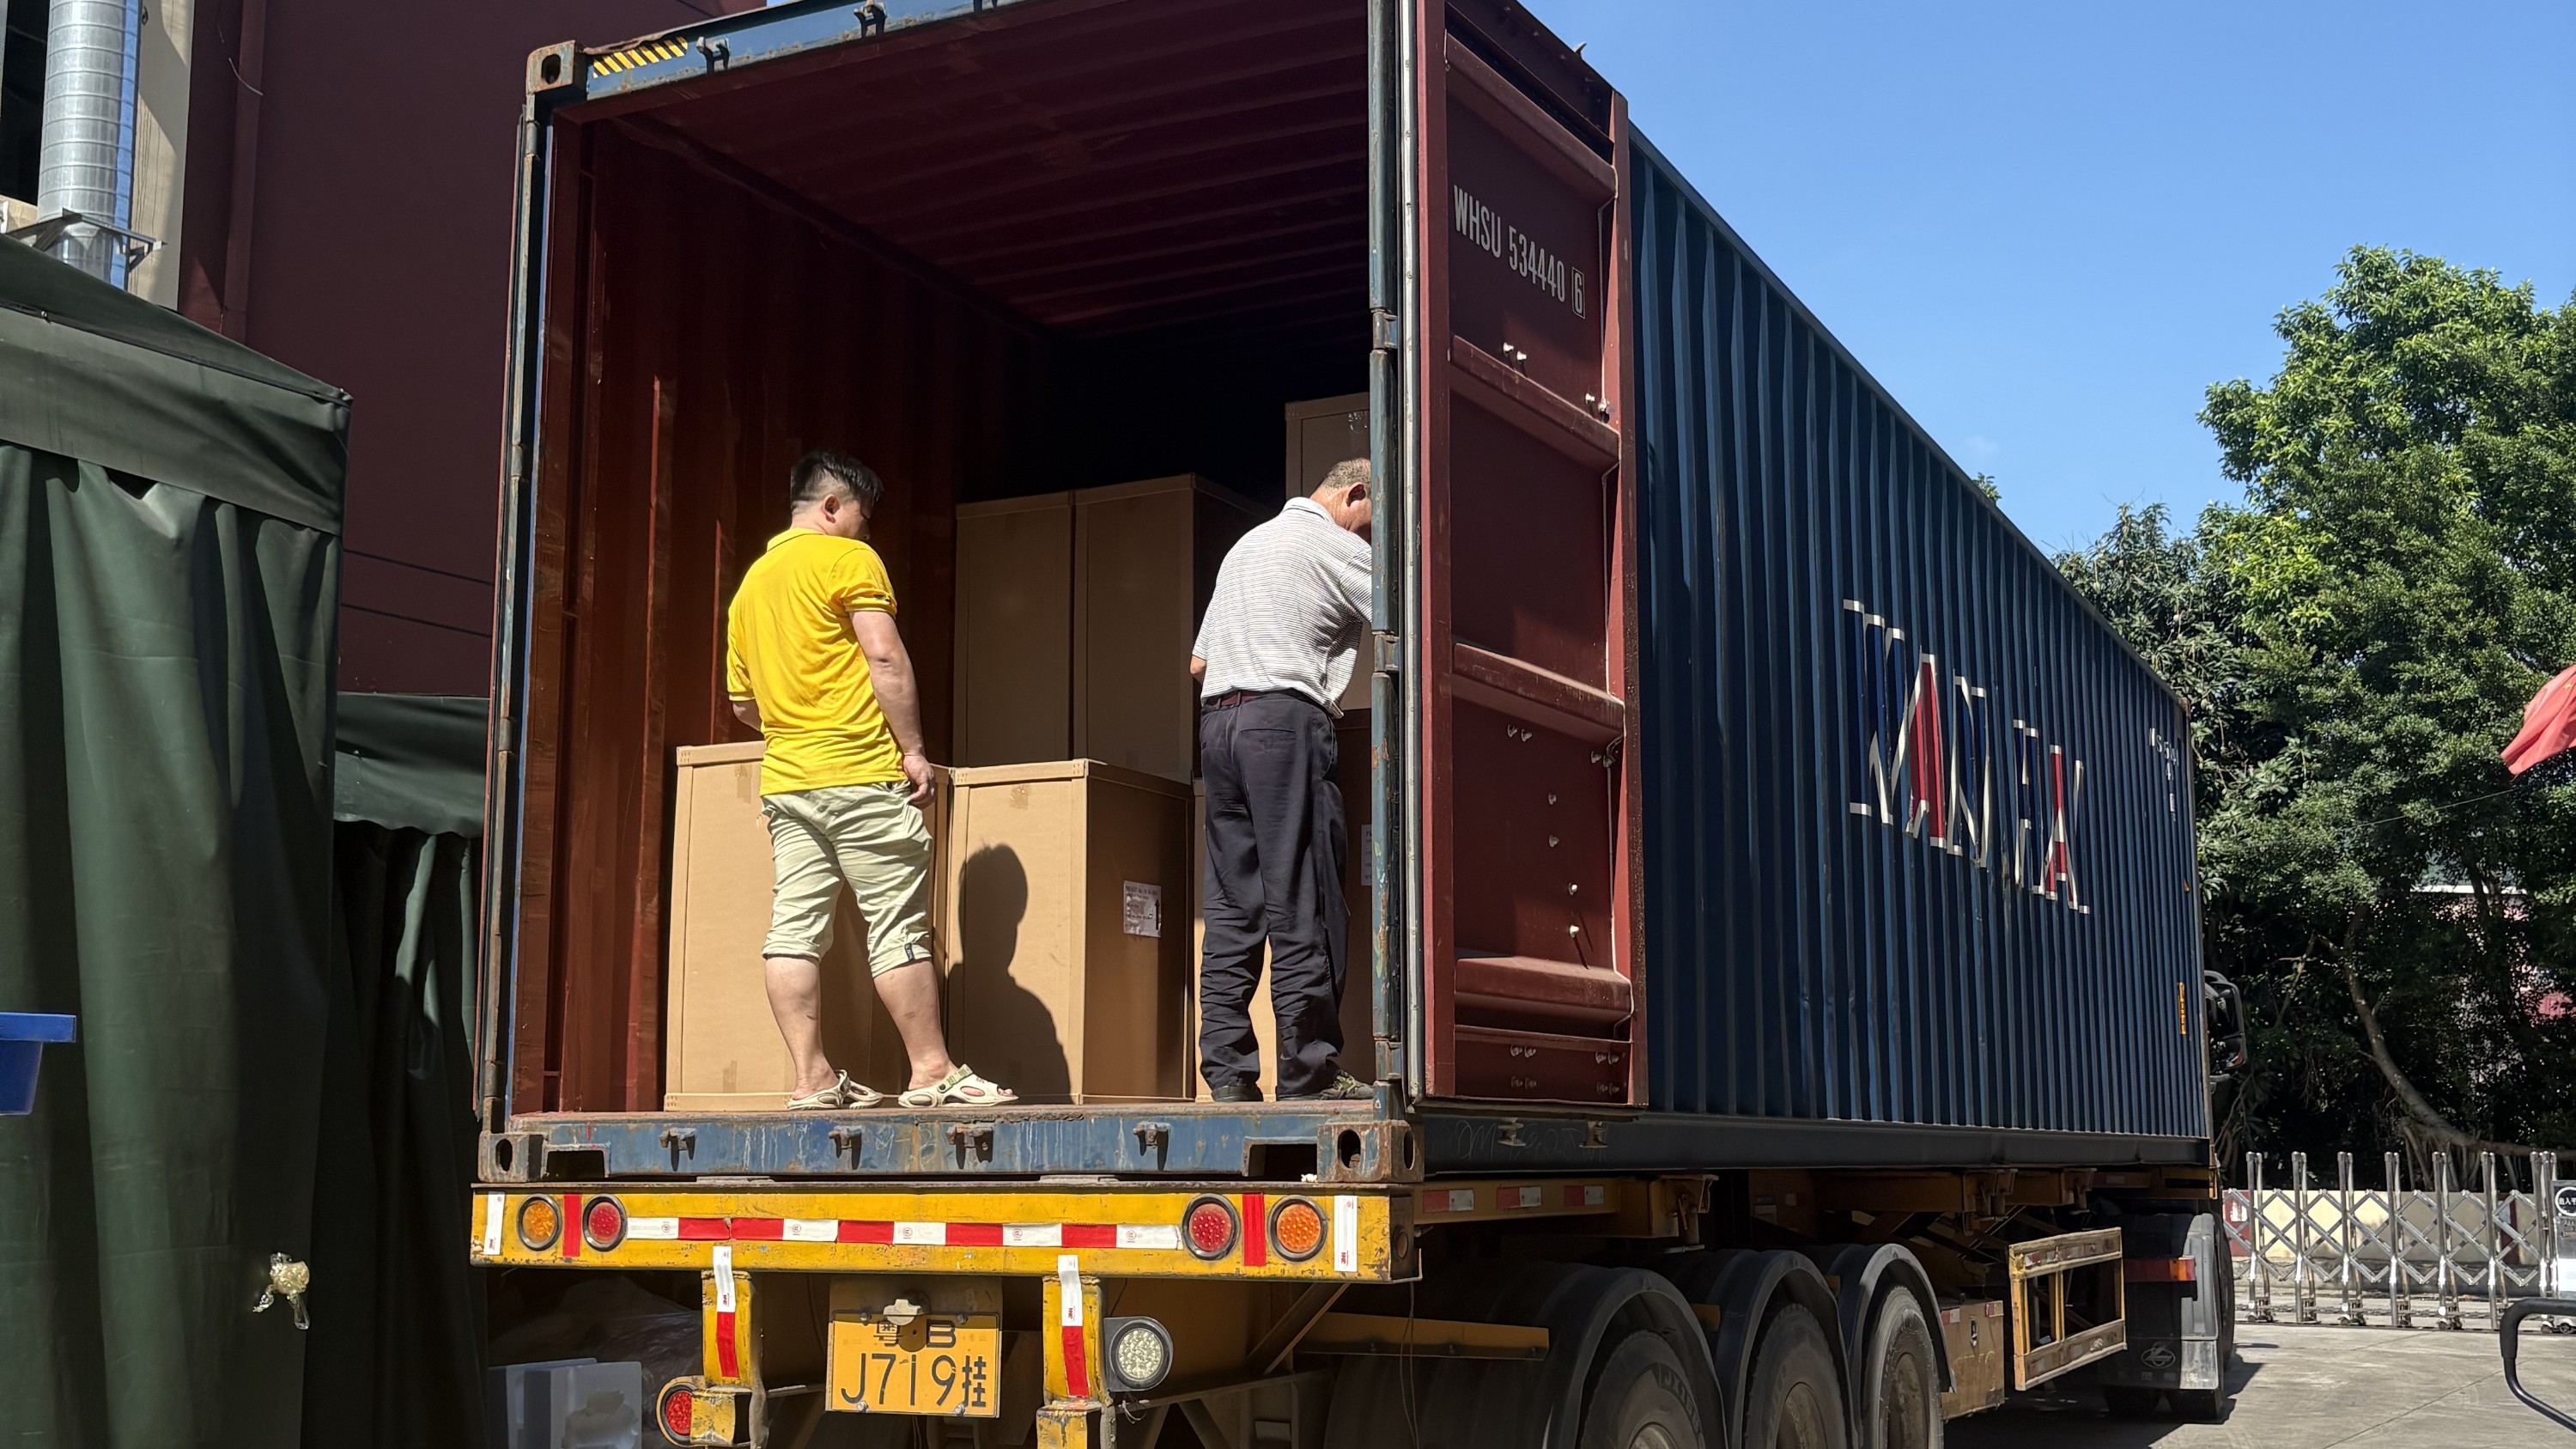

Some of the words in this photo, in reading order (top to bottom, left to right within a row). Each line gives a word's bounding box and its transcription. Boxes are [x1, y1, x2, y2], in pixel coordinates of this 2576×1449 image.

[1453, 184, 1502, 259] WHSU
[1508, 224, 1565, 302] 534440
[1573, 271, 1583, 315] 6
